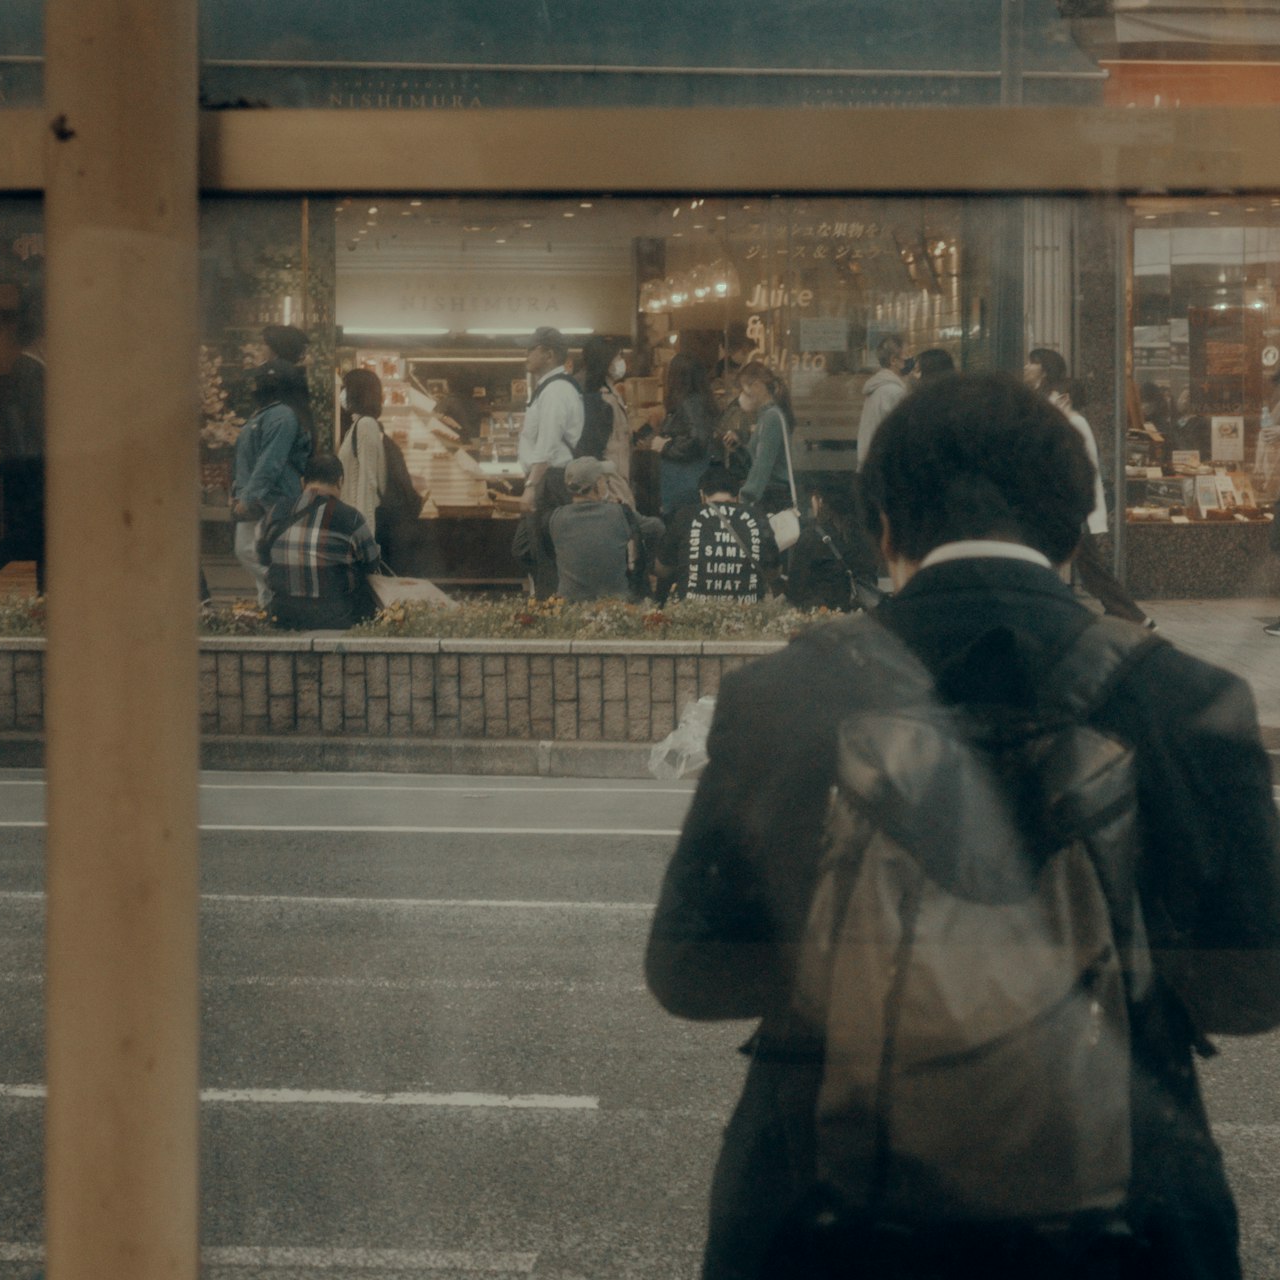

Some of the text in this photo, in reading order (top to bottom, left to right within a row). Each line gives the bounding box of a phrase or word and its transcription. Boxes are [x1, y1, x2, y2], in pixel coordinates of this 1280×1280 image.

[745, 279, 814, 308] Juice
[400, 296, 560, 312] NISHIMURA
[690, 519, 702, 559] LIGHT
[688, 564, 698, 588] THE
[707, 562, 743, 574] LIGHT
[705, 579, 741, 590] THAT
